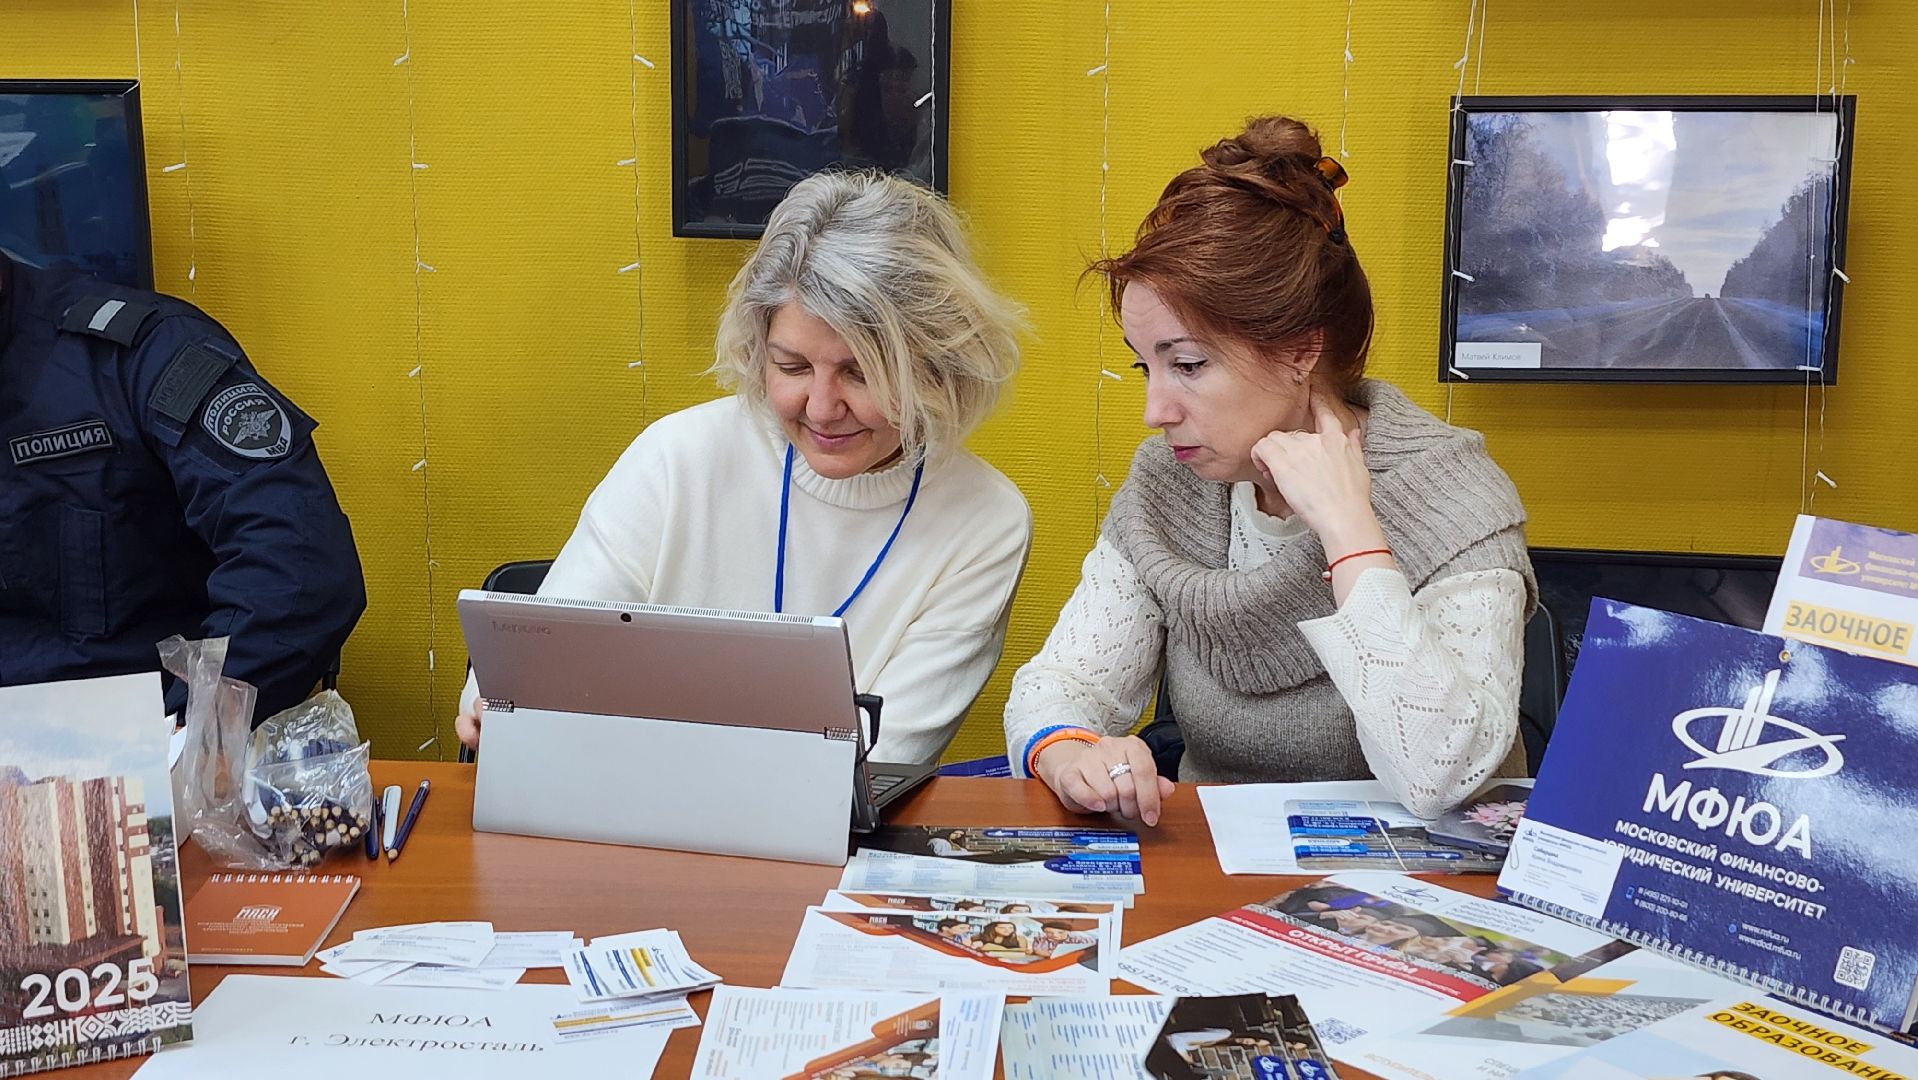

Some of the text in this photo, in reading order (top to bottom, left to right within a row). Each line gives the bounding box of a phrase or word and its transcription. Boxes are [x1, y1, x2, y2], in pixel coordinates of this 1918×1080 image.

[206, 384, 260, 431] ПОЛИЦИЯ
[222, 399, 266, 436] РОССИЯ
[16, 427, 107, 458] ПОЛИЦИЯ
[265, 438, 288, 456] МВД
[1786, 604, 1908, 650] ЗАОЧНОЕ
[1642, 772, 1812, 860] МФЮА
[1615, 820, 1717, 863] МОСКОВСКИЙ
[1719, 849, 1825, 894] ФИНАНСОВО-
[1714, 872, 1827, 920] УНИВЕРСИТЕТ
[1288, 929, 1359, 955] ОТКРЫТ
[20, 957, 159, 1019] 2025
[290, 1032, 544, 1052] г. Электросталь
[370, 1013, 492, 1028] МФЮА
[1733, 1002, 1868, 1053] ЗАОЧНОЕ
